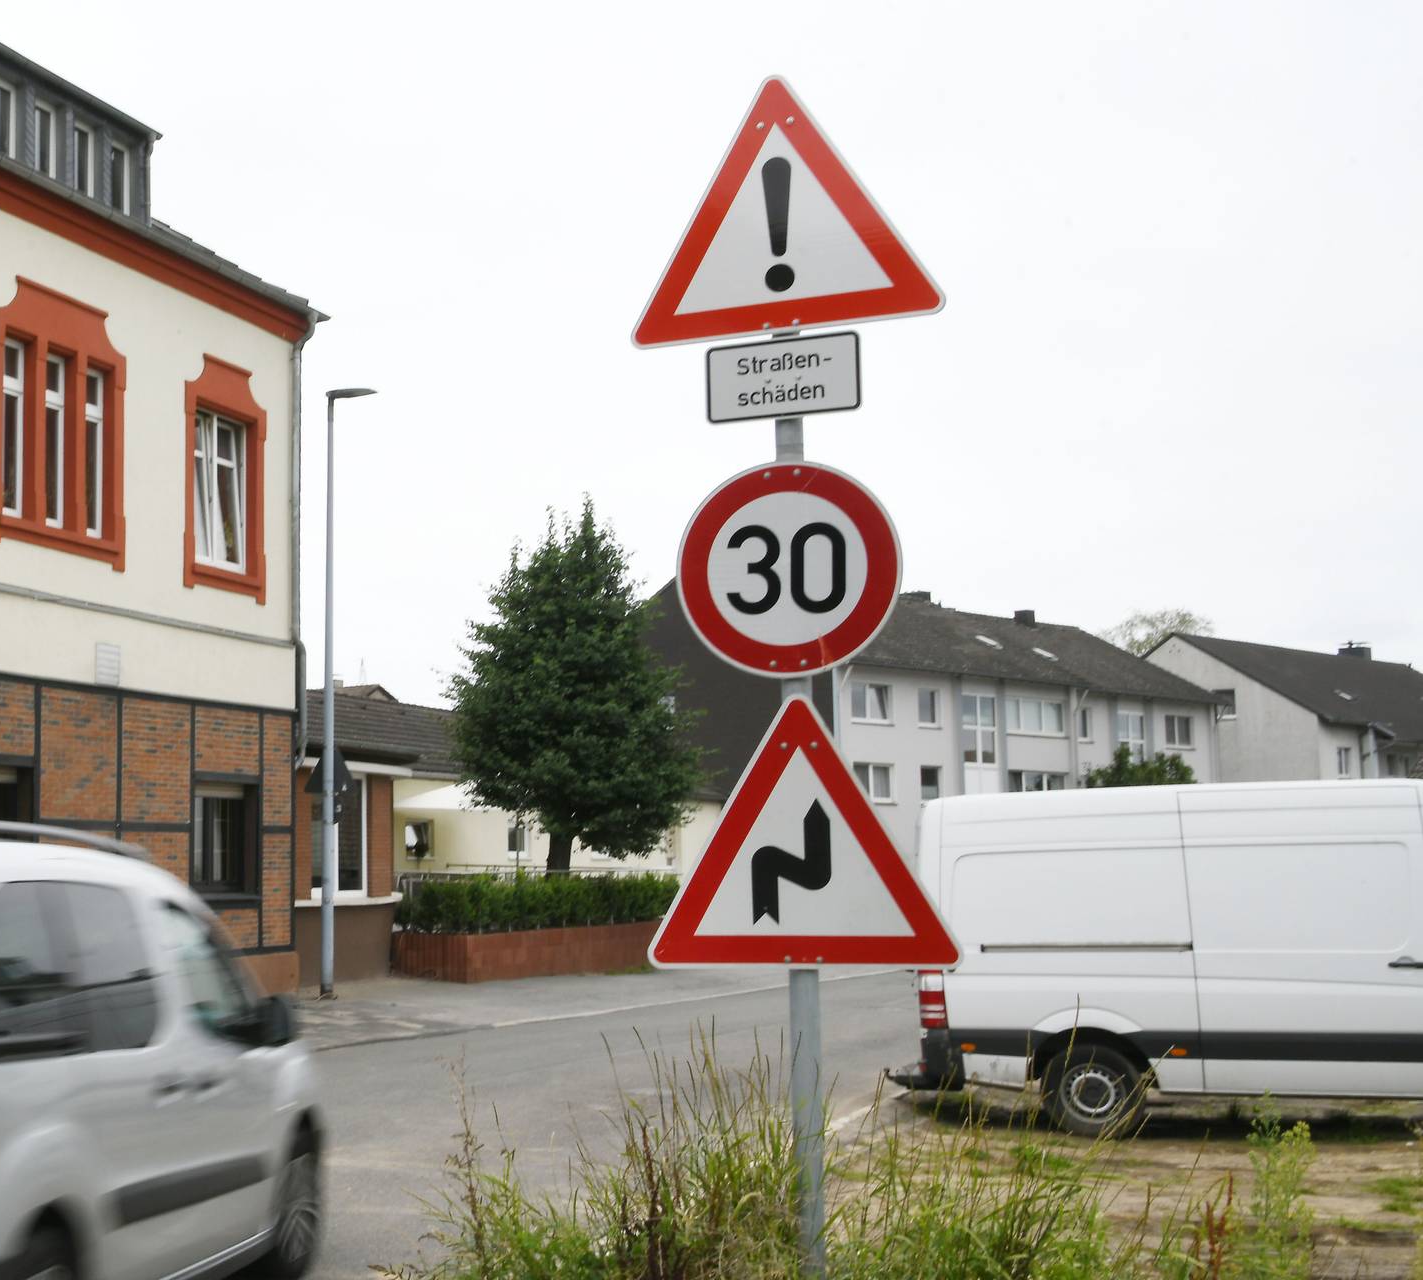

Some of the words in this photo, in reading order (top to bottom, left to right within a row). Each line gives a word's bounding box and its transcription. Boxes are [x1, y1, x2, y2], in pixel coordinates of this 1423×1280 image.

[736, 352, 832, 376] Straßen-
[737, 383, 825, 407] schäden
[726, 521, 846, 616] 30
